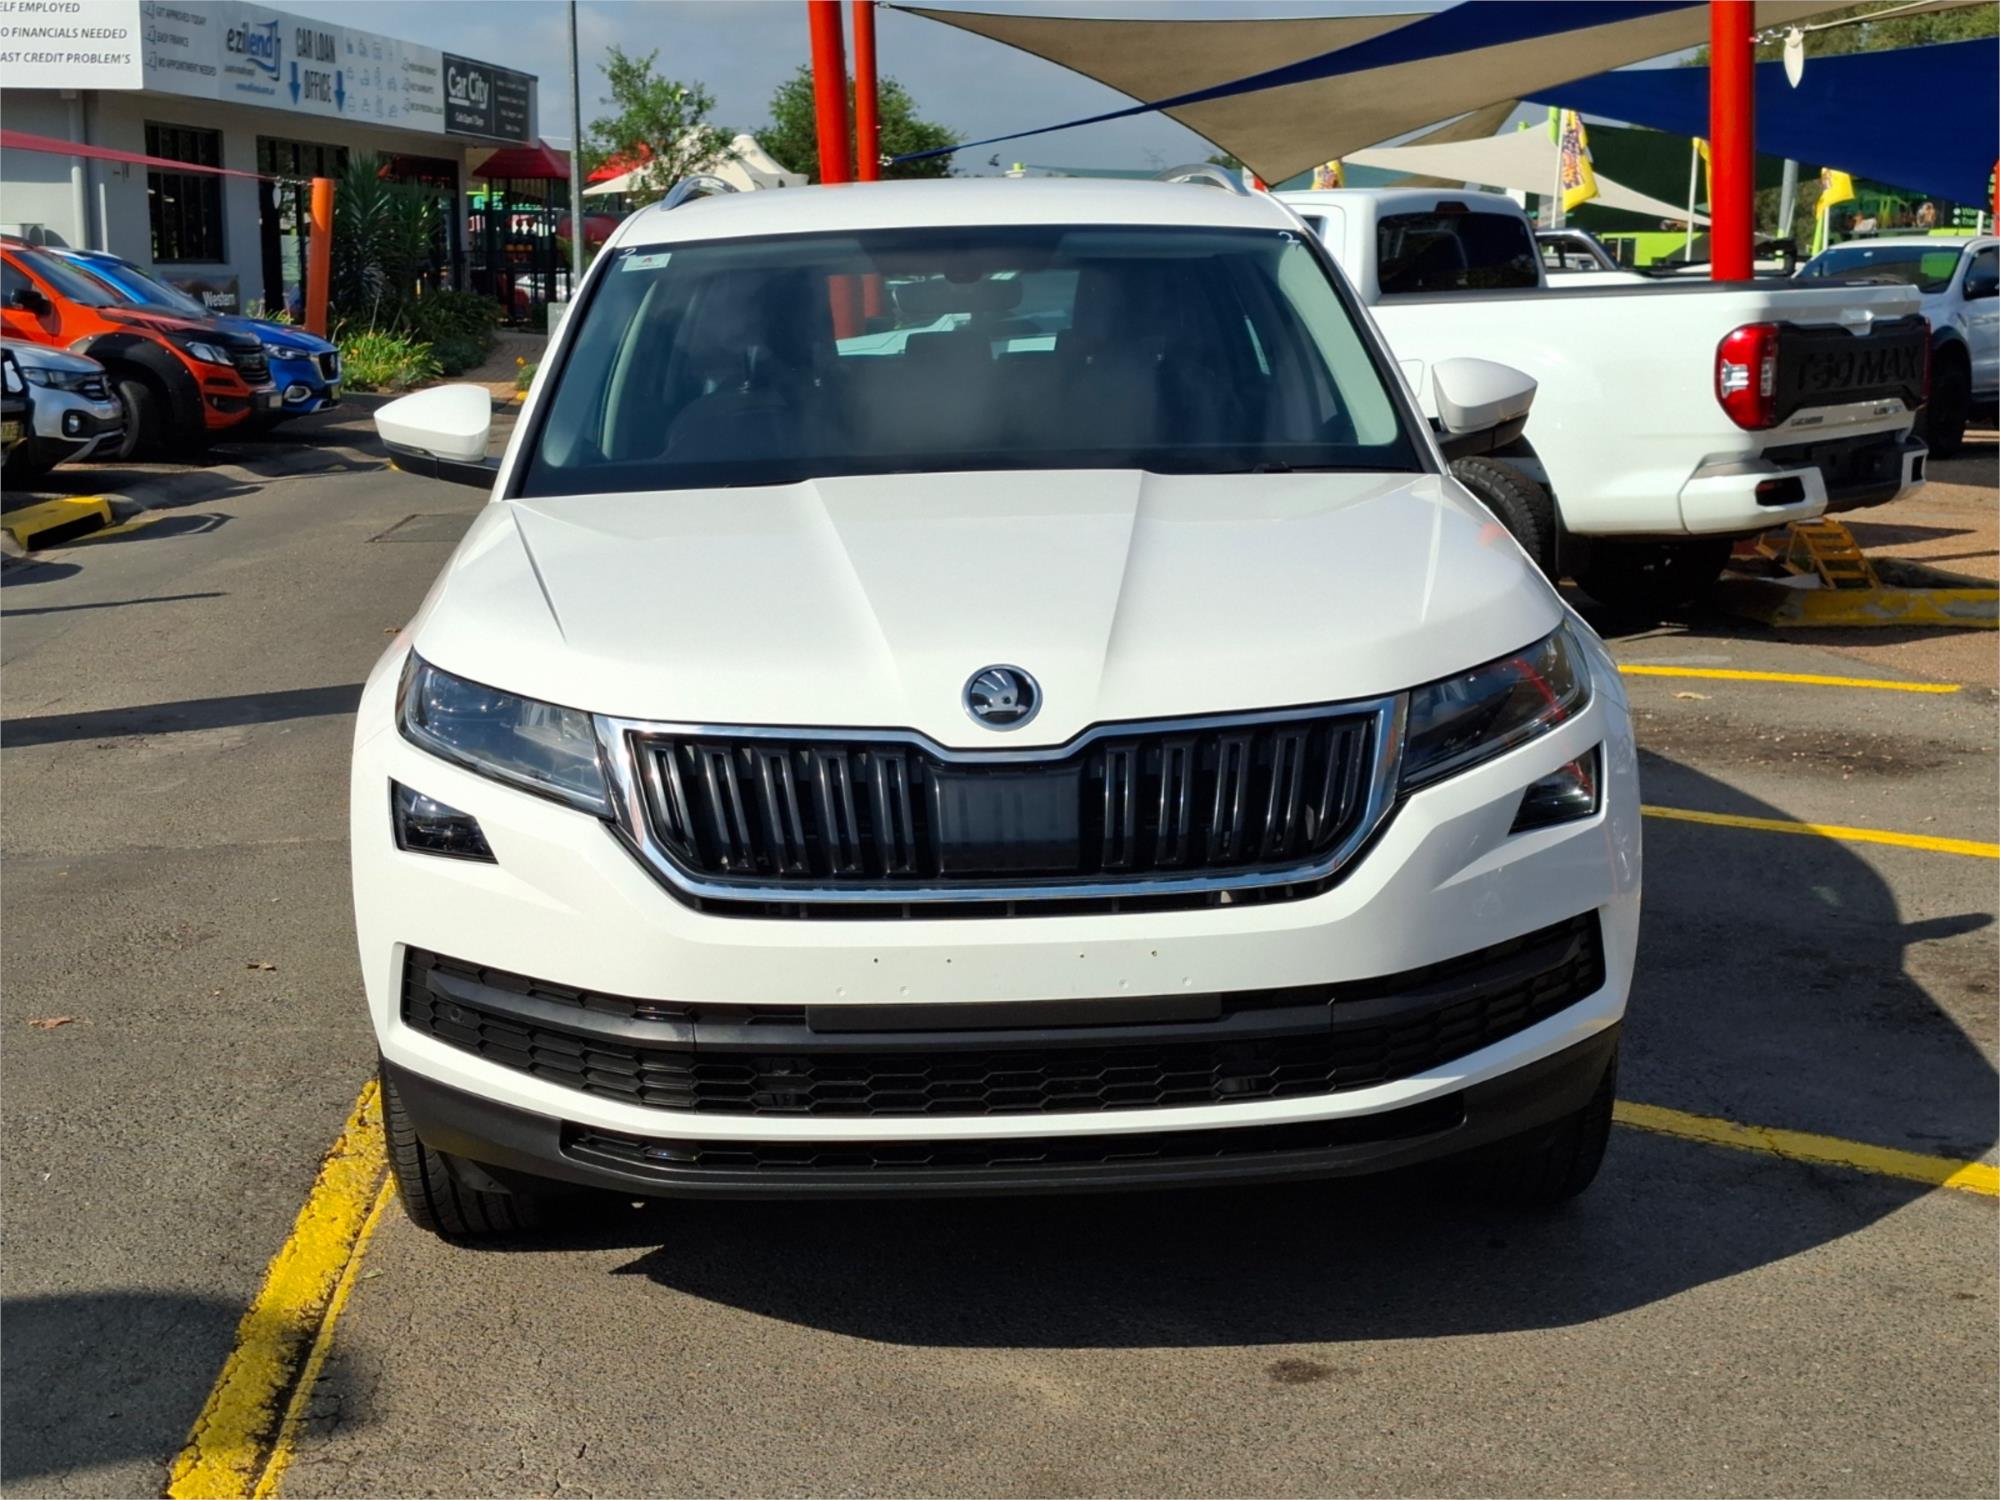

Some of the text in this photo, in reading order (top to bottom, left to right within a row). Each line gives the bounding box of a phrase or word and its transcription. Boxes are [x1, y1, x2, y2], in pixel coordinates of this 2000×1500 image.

[18, 2, 80, 13] EMPLOYED
[11, 27, 79, 38] FINANCIALS
[81, 28, 128, 39] NEEDED
[296, 27, 336, 64] CAR LOAN
[23, 52, 65, 63] CREDIT
[66, 53, 131, 64] PROBLEM'S
[304, 69, 332, 103] OFFICE
[447, 66, 489, 110] Car City
